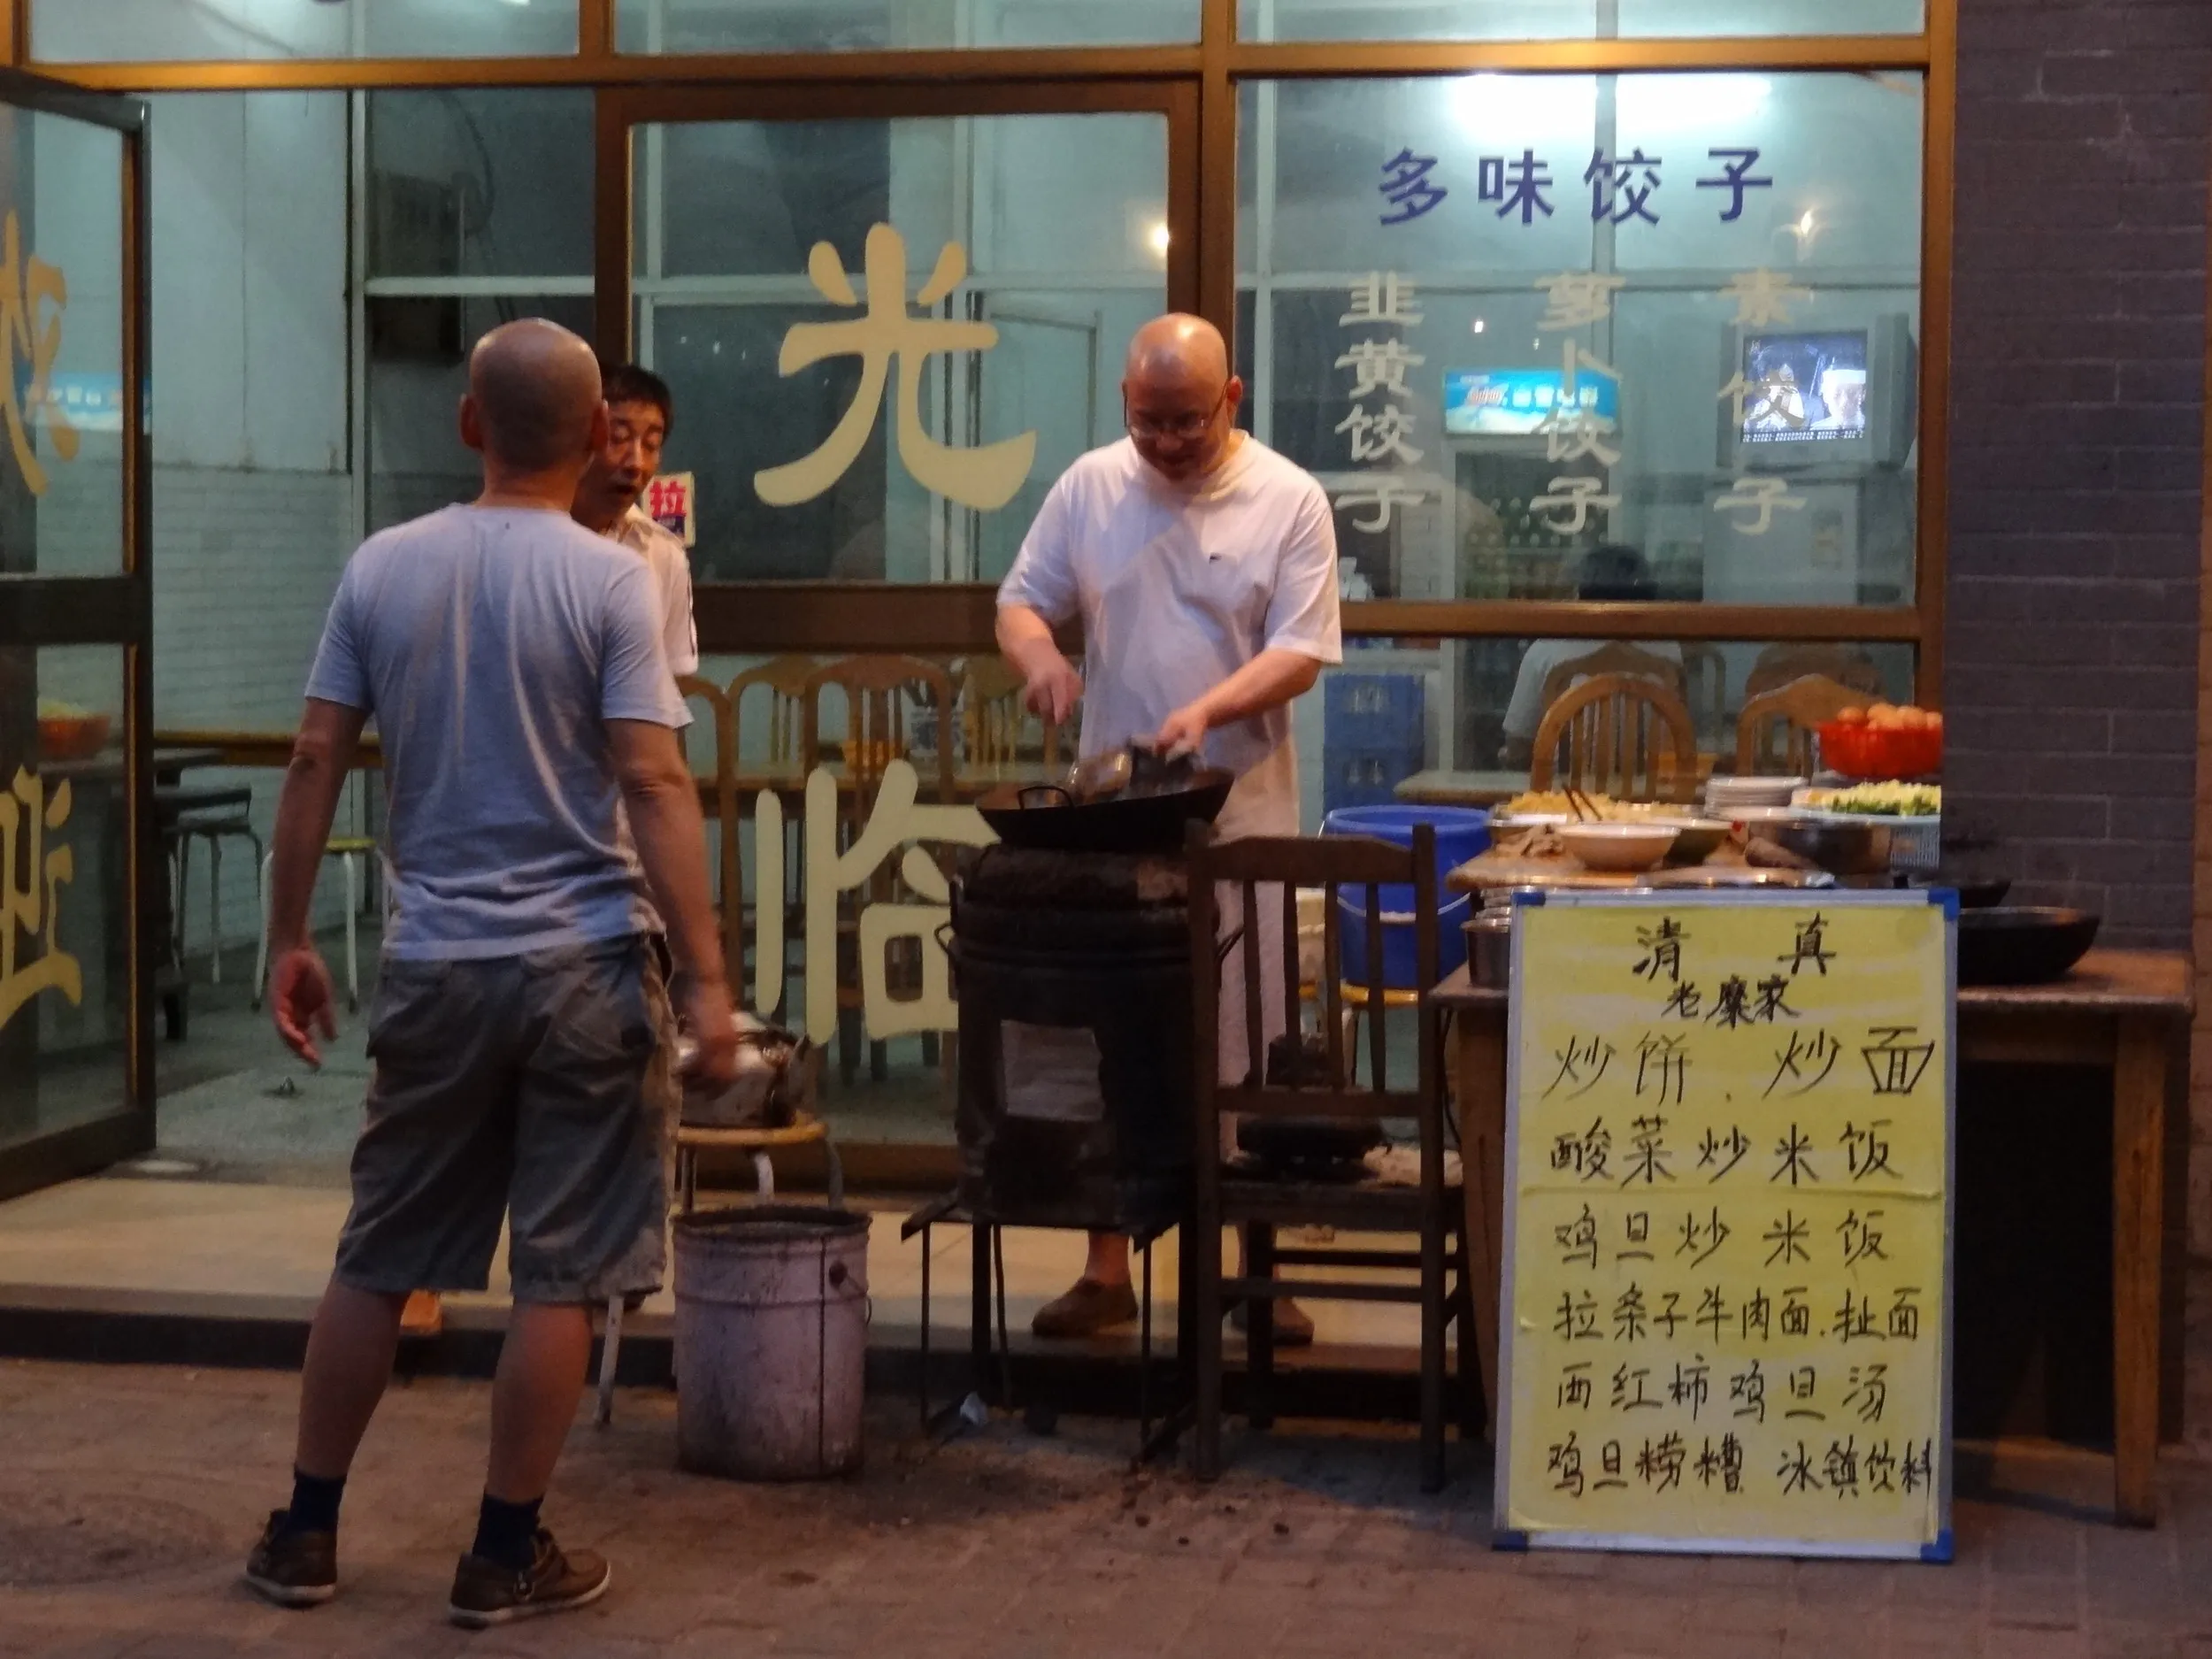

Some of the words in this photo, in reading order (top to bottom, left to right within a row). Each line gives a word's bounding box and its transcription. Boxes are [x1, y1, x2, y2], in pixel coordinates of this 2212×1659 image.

[1378, 147, 1773, 227] 多味饺子
[1334, 269, 1426, 533] 韭黄饺子
[1529, 271, 1626, 534] 萝卜饺子
[649, 480, 687, 518] 拉
[754, 221, 1037, 1046] 光临
[1632, 911, 1837, 983] 清真
[1550, 1113, 1904, 1190] 酸菜炒米饭
[1554, 1202, 1890, 1269] 鸡旦炒米饭
[1557, 1352, 1890, 1424] 西红柿鸡旦汤
[1777, 1433, 1932, 1501] 冰镇饮料
